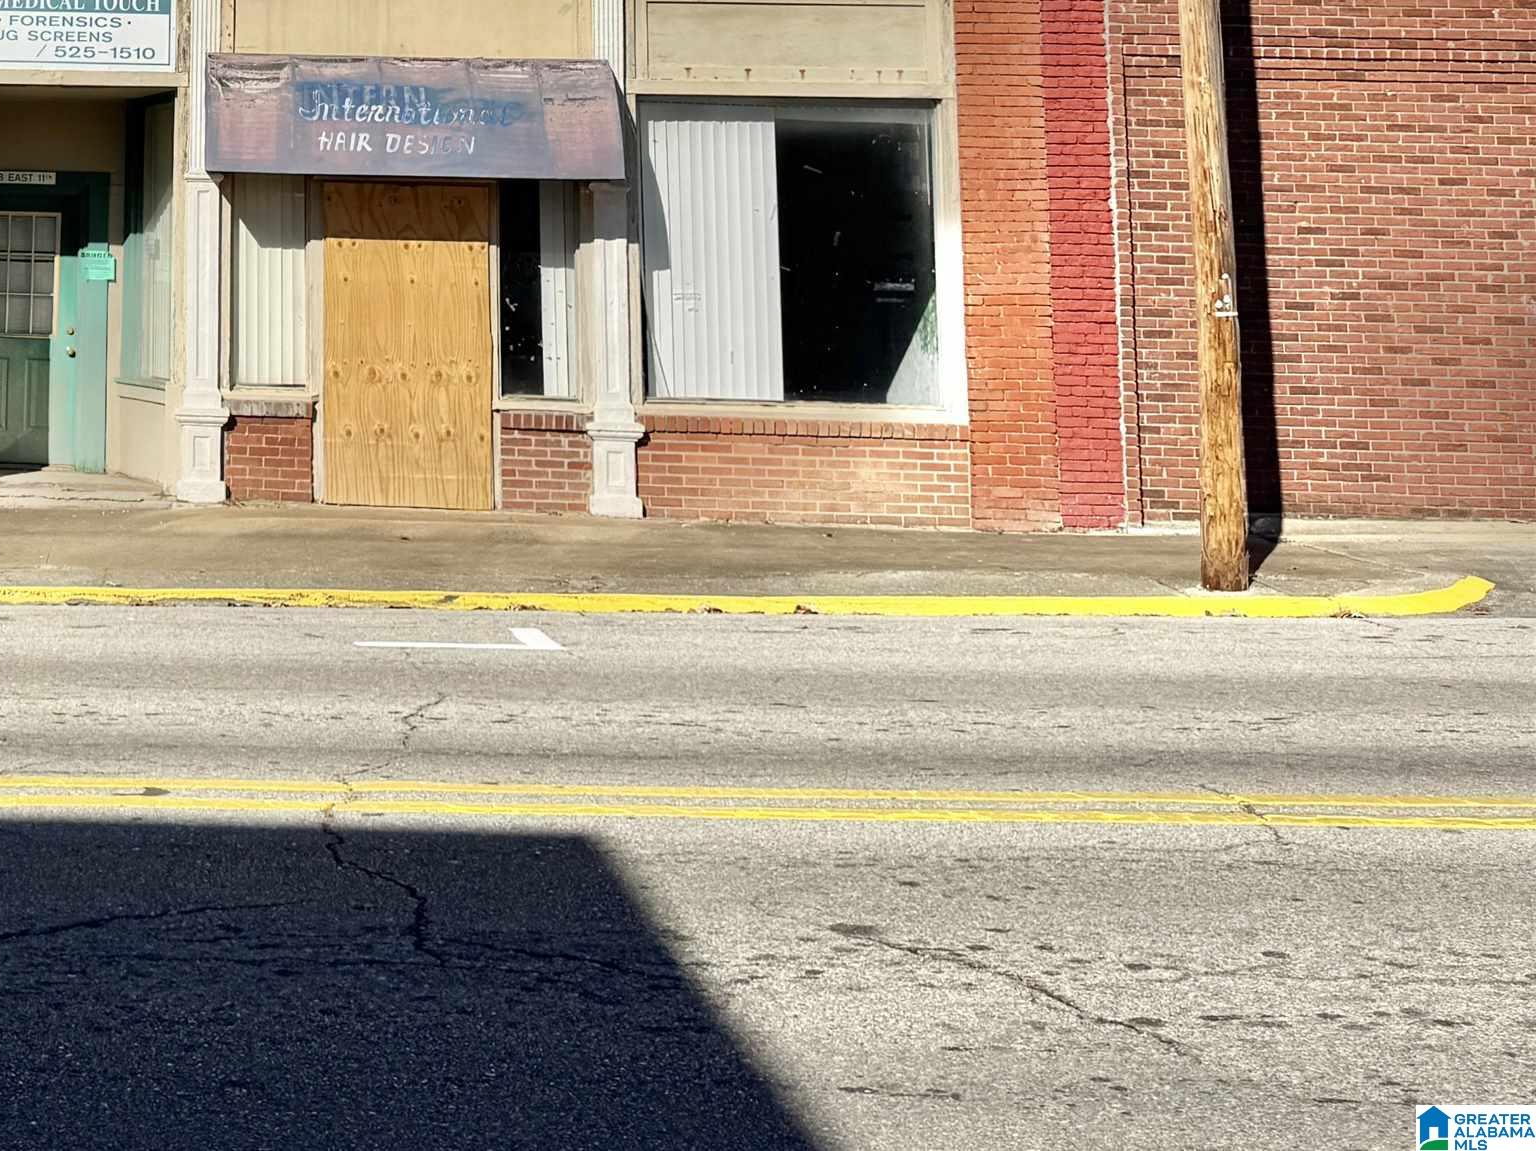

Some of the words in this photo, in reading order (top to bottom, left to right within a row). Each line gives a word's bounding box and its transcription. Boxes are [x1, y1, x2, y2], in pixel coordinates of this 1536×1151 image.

[9, 15, 122, 28] FORENSICS
[27, 30, 113, 43] SCREENS
[54, 46, 156, 60] 525-1510
[318, 131, 372, 152] HAIR
[385, 133, 476, 155] DESIGN
[8, 173, 33, 183] EAST
